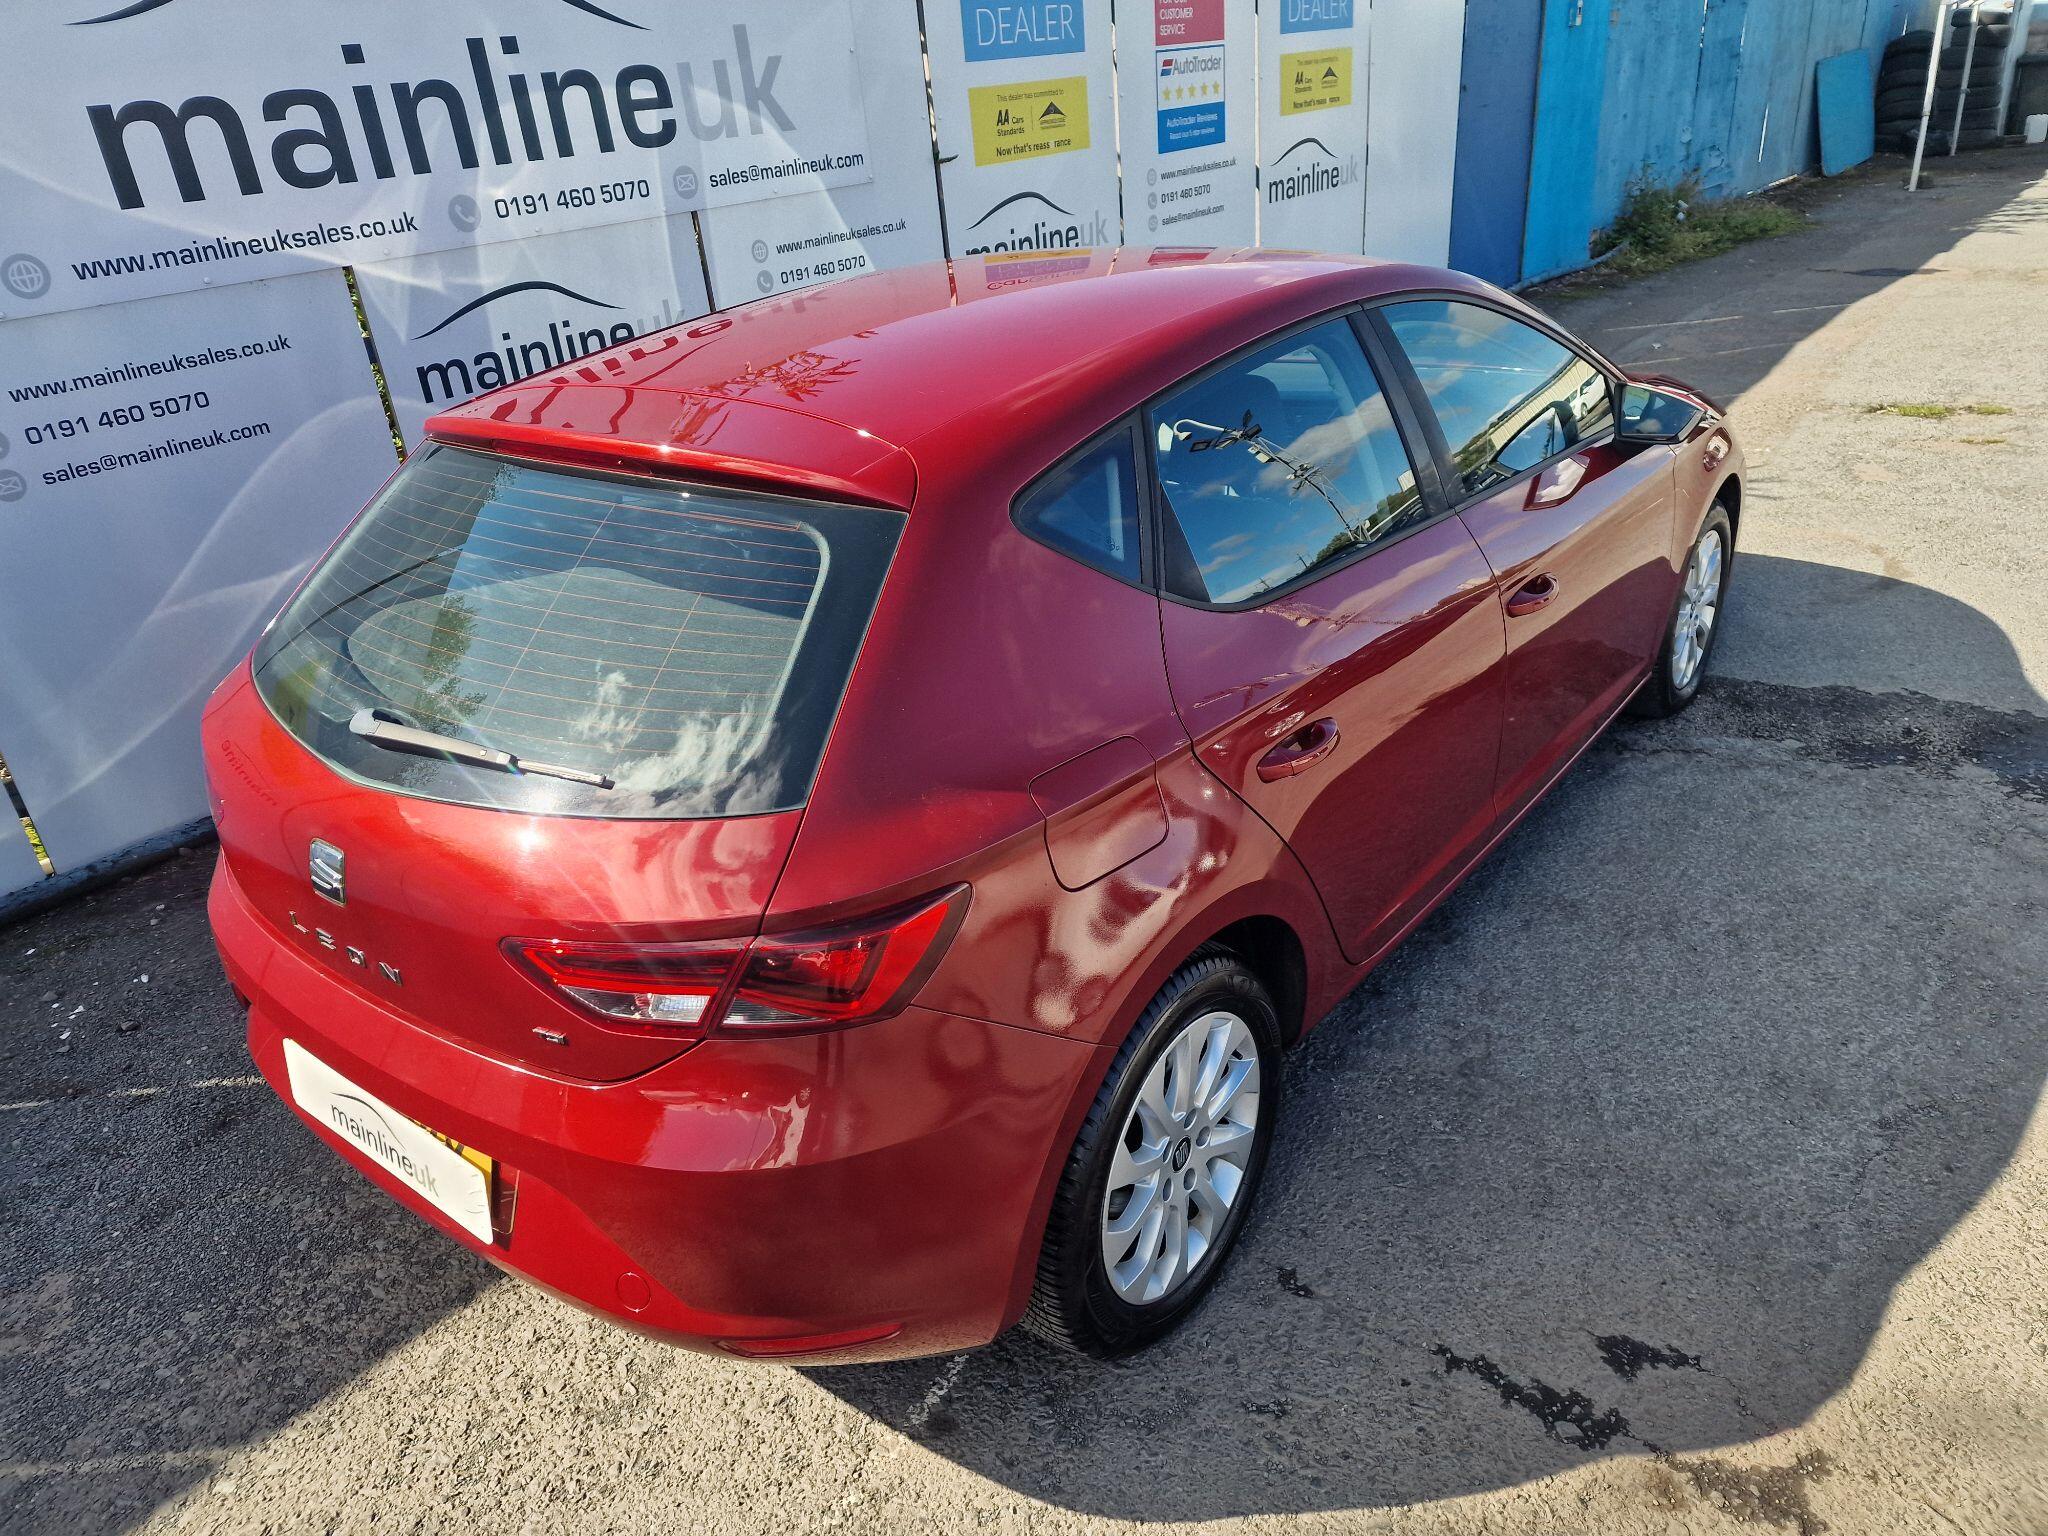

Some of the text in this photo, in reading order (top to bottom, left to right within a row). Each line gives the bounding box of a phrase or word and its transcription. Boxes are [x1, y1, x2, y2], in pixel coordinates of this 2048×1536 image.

[976, 4, 1076, 46] DEALER
[1159, 7, 1194, 20] CUSTOMER
[1288, 0, 1349, 22] DEALER
[1159, 23, 1186, 36] SERVICE
[1172, 55, 1222, 76] AutoTrader
[86, 22, 796, 210] mainlineuk
[996, 108, 1010, 126] AA
[1011, 116, 1025, 124] Cars
[997, 127, 1025, 137] Standards
[996, 147, 1013, 157] Now
[1013, 142, 1032, 154] that's
[709, 152, 865, 188] sales@mainlineuk.com
[1160, 156, 1237, 181] www.mainlineuksales.co.uk
[1268, 154, 1358, 204] mainlineuk
[494, 179, 650, 219] 0191 460 5070
[1161, 183, 1211, 204] 0191 460 5070
[70, 211, 419, 281] www.mainlineuksales.co.uk
[776, 218, 907, 255] www.mainlineuksales.co.uk
[780, 255, 866, 285] 0191 460 5070
[8, 334, 292, 403] www.mainlineuksales.co.uk
[24, 391, 210, 446] 0191 460 5070
[42, 422, 271, 485] sales@mainlineuk.com
[288, 909, 403, 986] LEON
[330, 1103, 440, 1199] mainlineuk
